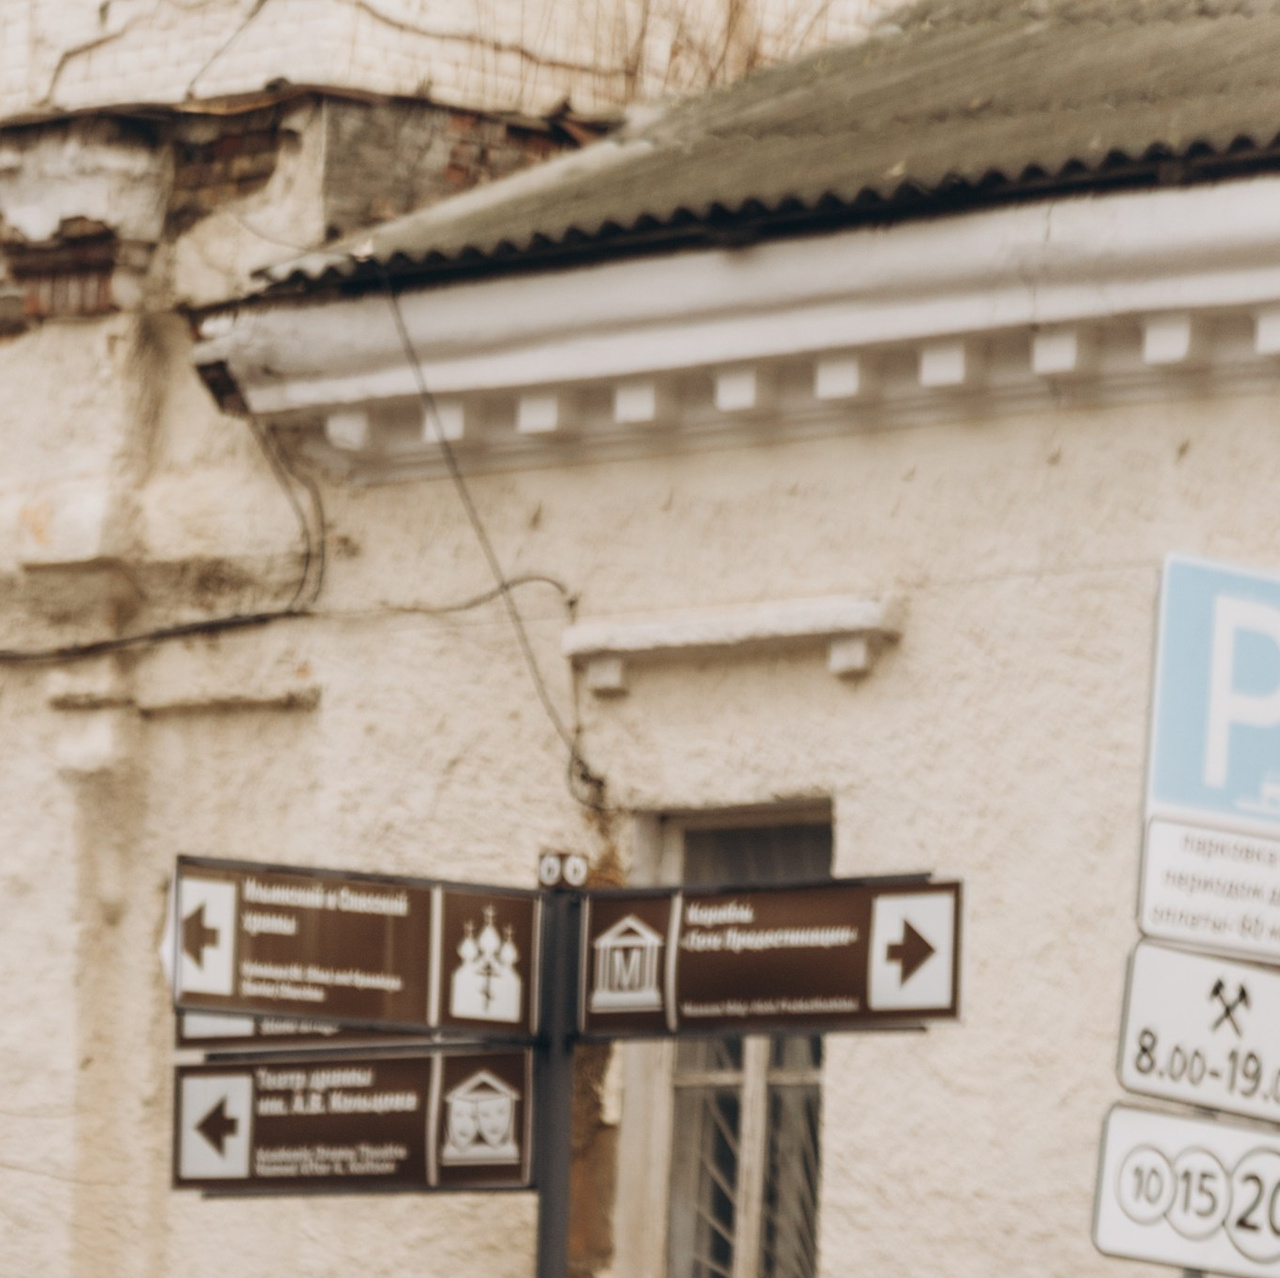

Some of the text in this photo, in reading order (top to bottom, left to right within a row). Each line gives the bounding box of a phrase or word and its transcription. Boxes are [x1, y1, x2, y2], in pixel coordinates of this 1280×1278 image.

[1204, 594, 1280, 789] P
[255, 1067, 307, 1092] Театр
[1133, 1166, 1163, 1204] 10
[1180, 1169, 1218, 1217] 15
